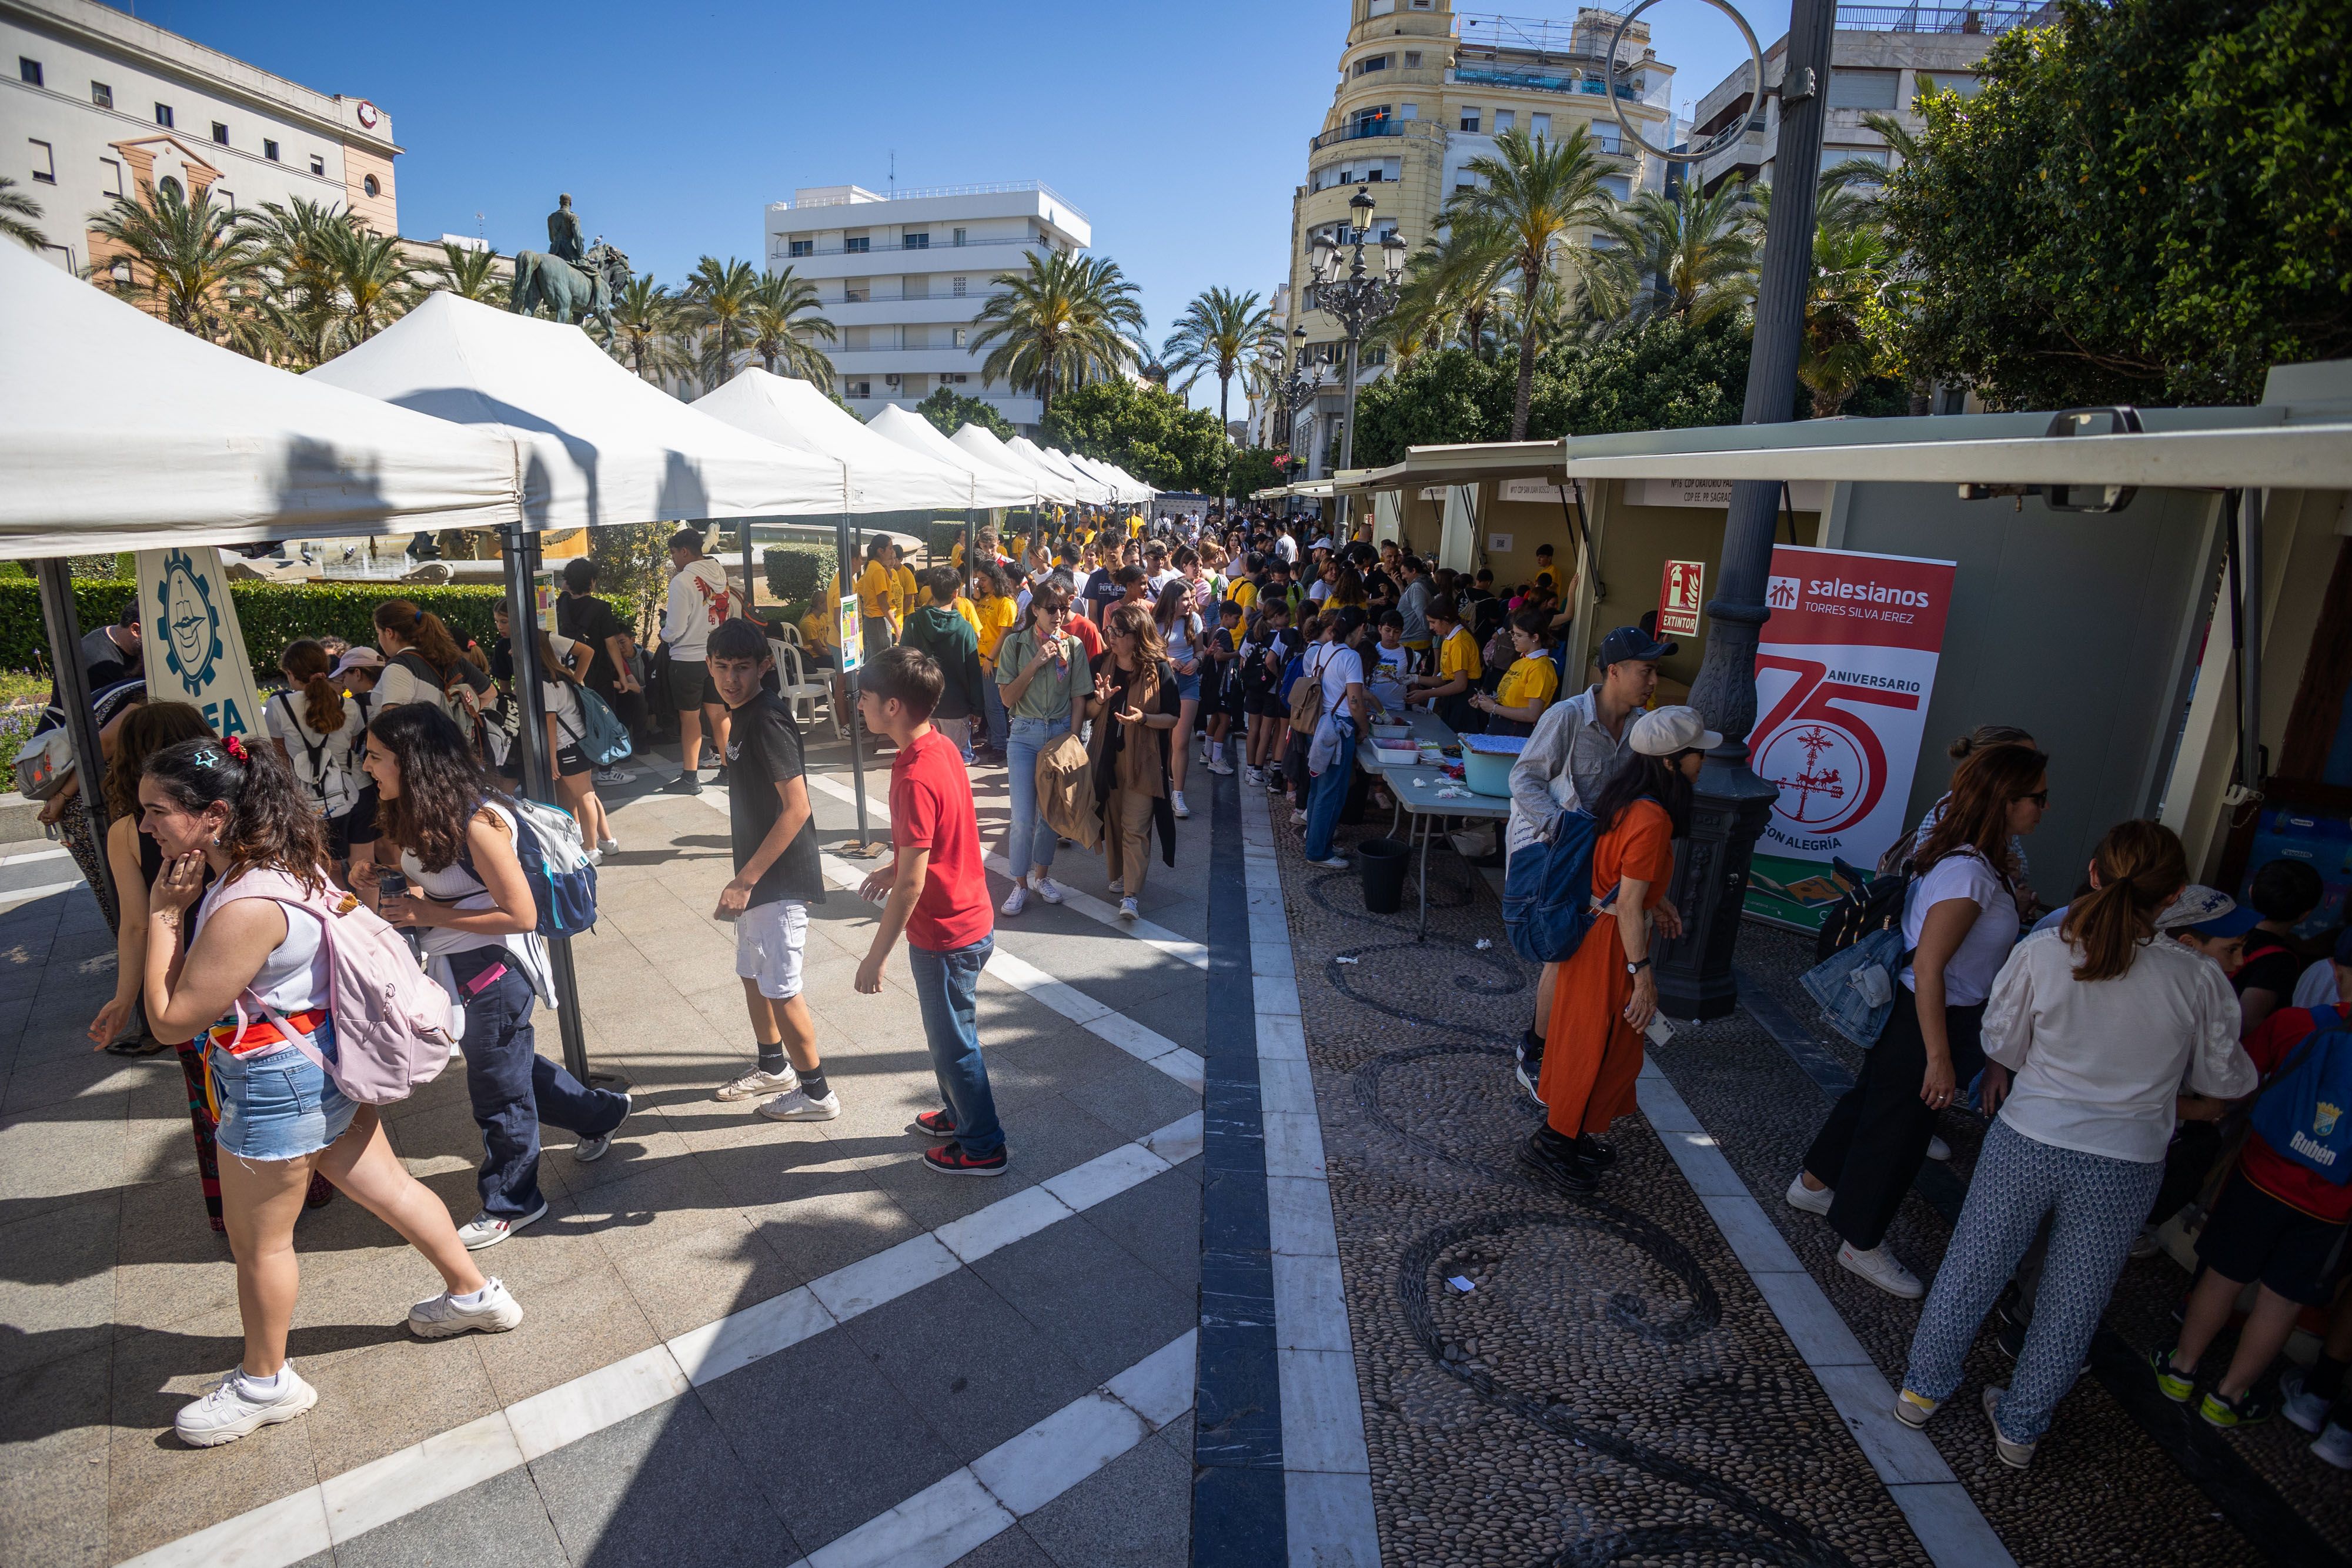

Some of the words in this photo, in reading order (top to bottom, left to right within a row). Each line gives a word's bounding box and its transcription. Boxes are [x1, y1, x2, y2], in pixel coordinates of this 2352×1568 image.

[1684, 479, 1695, 488] CDP
[1695, 479, 1721, 488] ORATORIO
[1683, 492, 1694, 502] CDP
[1807, 577, 1929, 608] salesianos
[1663, 615, 1695, 630] EXTINTOR
[1805, 601, 1846, 616] TORRES
[1848, 607, 1878, 620] SILVA
[1880, 611, 1915, 624] JEREZ
[1828, 670, 1920, 693] ANIVERSARIO
[1746, 653, 1920, 834] 75
[1785, 836, 1842, 851] ALEGRÍA
[2290, 1130, 2337, 1166] Rubén
